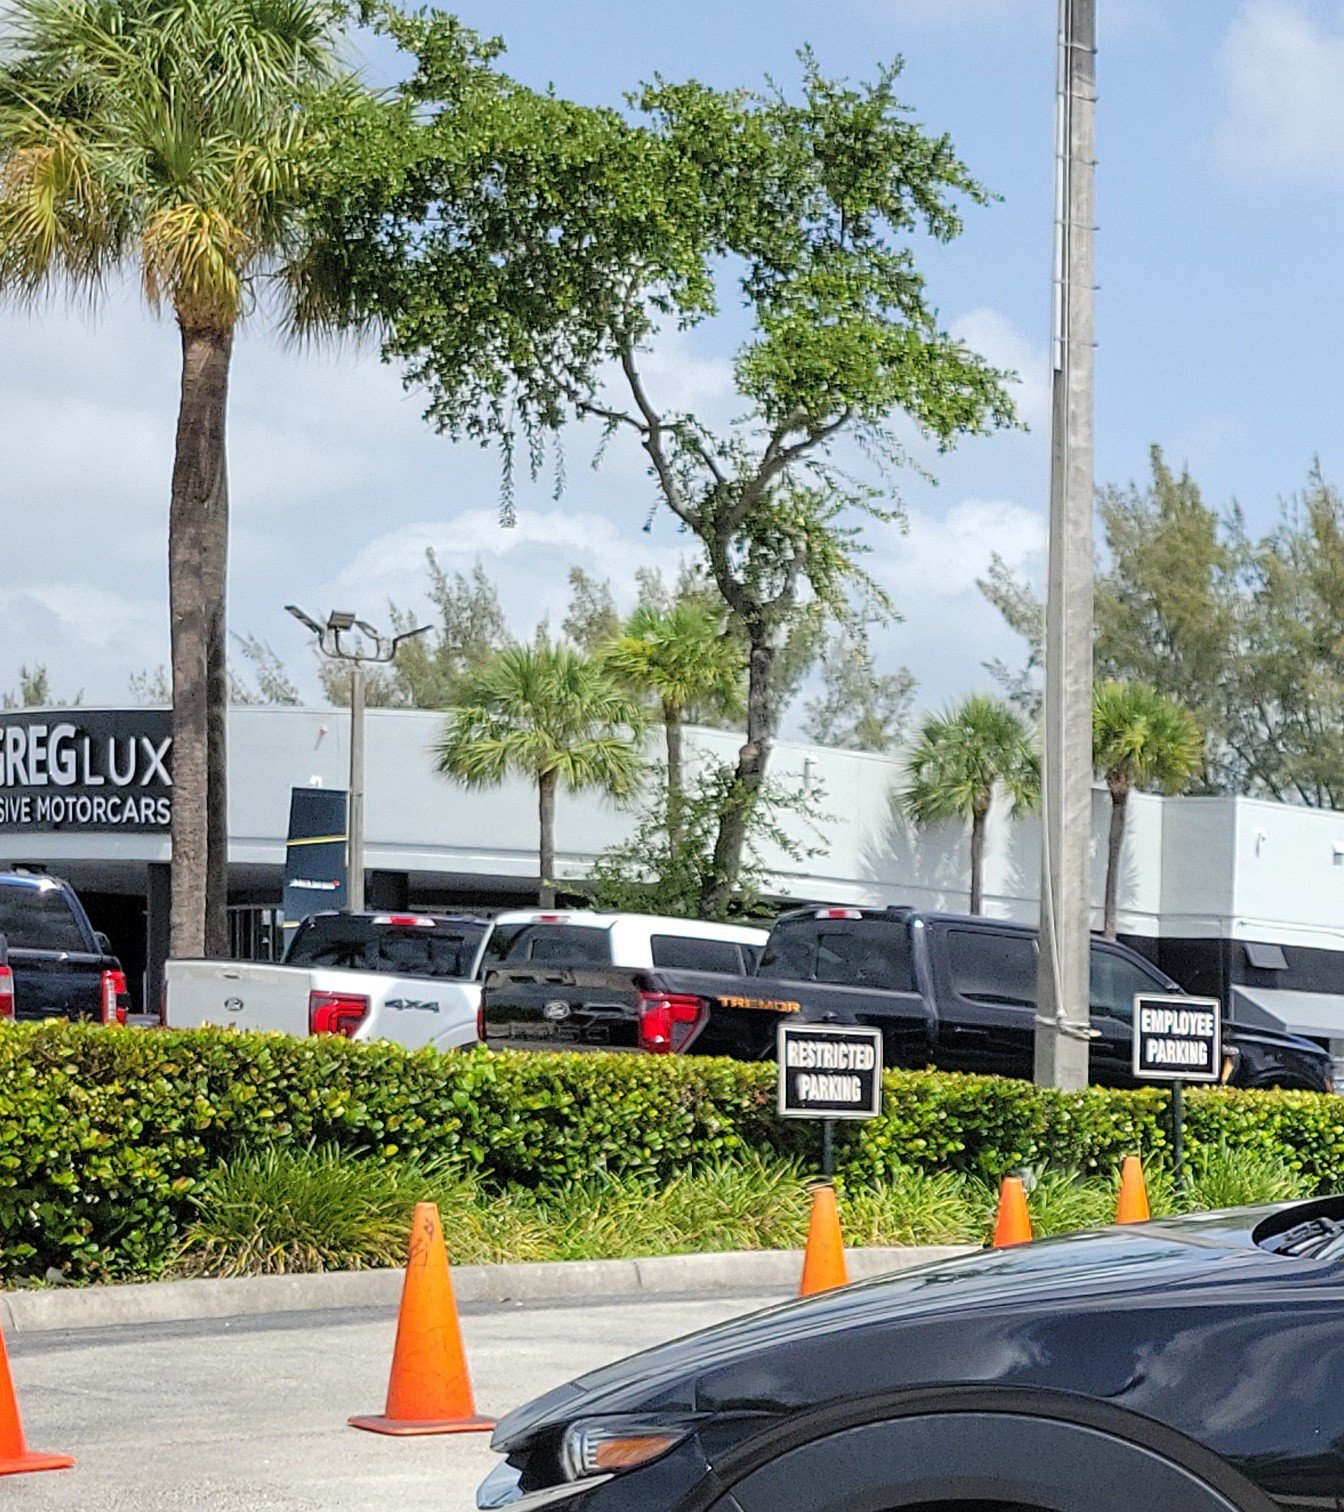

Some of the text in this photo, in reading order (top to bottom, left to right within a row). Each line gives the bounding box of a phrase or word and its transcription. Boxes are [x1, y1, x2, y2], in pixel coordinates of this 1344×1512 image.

[37, 796, 171, 825] MOTORCARS
[715, 994, 800, 1013] TREMOR
[1141, 1007, 1214, 1037] EMPLOYEE
[786, 1039, 875, 1071] RESTRICTED
[1146, 1038, 1208, 1065] PARKING
[797, 1073, 862, 1102] PARKING
